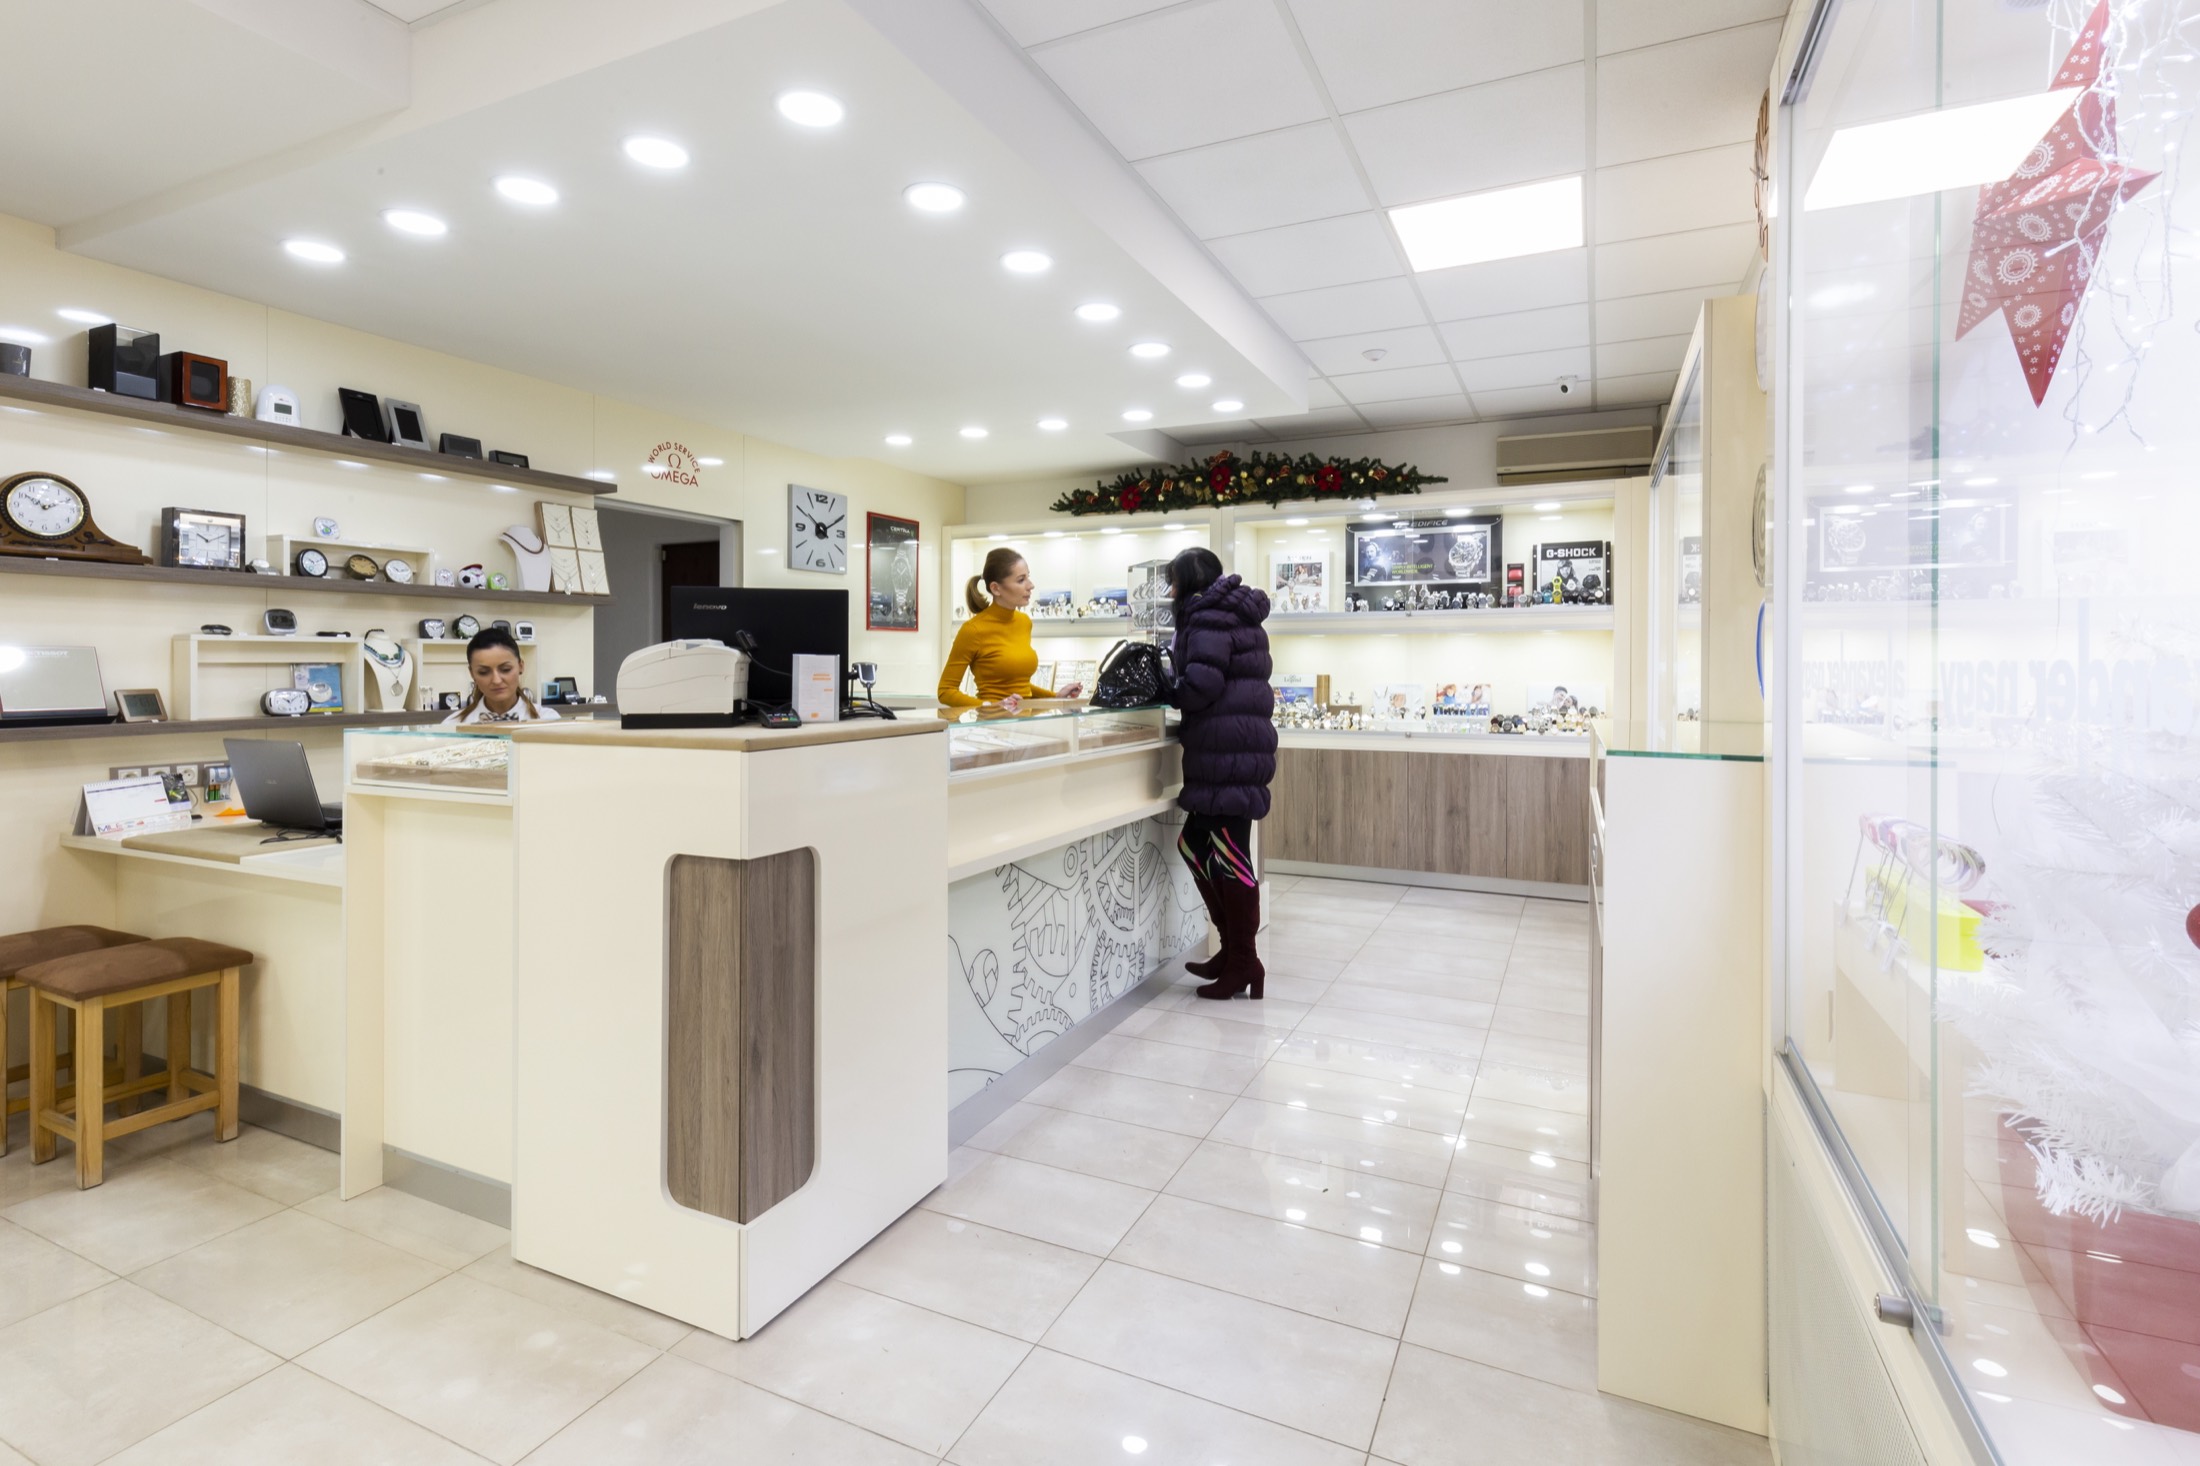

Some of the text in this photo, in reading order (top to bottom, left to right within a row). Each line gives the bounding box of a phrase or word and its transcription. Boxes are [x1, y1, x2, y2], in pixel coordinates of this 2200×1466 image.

[648, 441, 701, 474] WORLD SERVICE
[814, 493, 828, 504] 12
[795, 522, 806, 532] 9
[836, 529, 846, 539] 3
[1545, 547, 1597, 559] G-SHOCK
[815, 558, 826, 568] 6
[693, 602, 728, 611] lenovo
